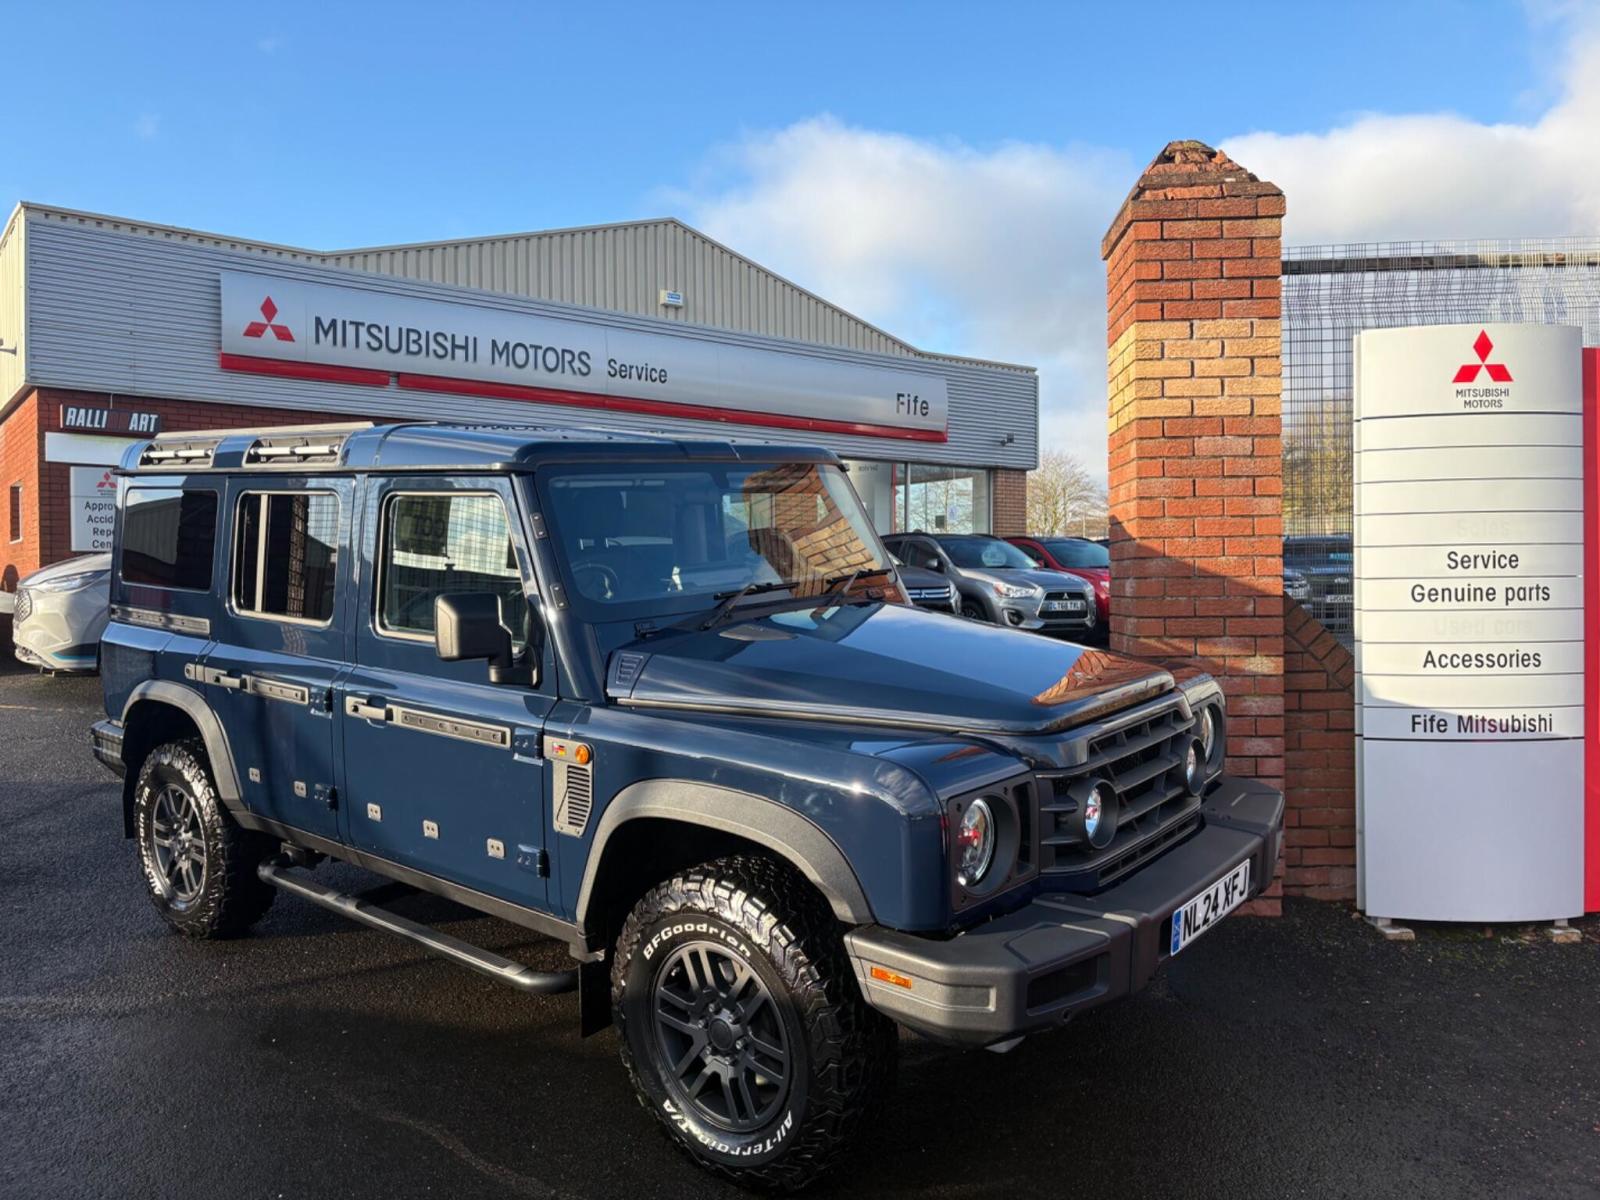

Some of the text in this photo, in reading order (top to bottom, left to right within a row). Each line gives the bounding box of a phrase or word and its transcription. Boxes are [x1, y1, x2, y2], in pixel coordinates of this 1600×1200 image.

[314, 315, 930, 417] MITSUBISHI MOTORS Service Fife
[1455, 388, 1510, 398] MITSUBISHI
[1463, 399, 1503, 409] MOTORS
[65, 407, 158, 432] RALLI ART
[86, 515, 115, 524] Accid
[92, 527, 114, 537] Rep
[1446, 550, 1519, 570] Service
[1411, 583, 1551, 606] Genuine parts
[1422, 649, 1542, 668] Accessories
[1411, 713, 1553, 734] Fife Mitsubishi
[1182, 865, 1248, 942] NL24 XFJ
